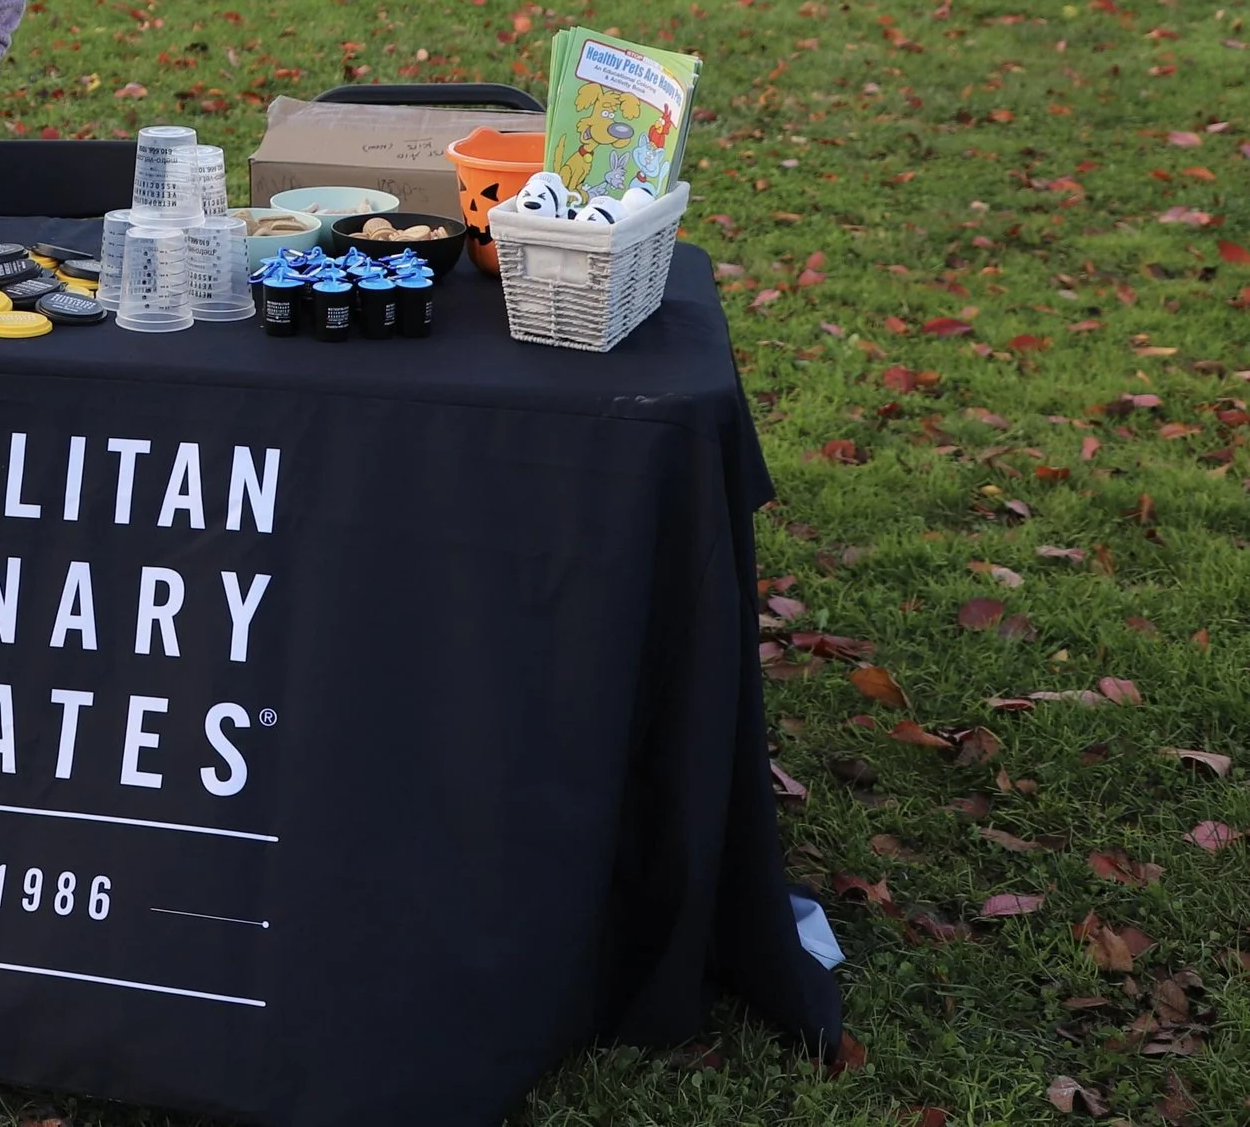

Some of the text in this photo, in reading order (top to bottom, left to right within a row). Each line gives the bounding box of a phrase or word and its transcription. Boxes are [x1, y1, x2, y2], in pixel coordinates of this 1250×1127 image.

[586, 46, 623, 71] Healthy
[622, 58, 645, 78] Pets
[644, 67, 659, 85] Are
[602, 66, 635, 83] Educational
